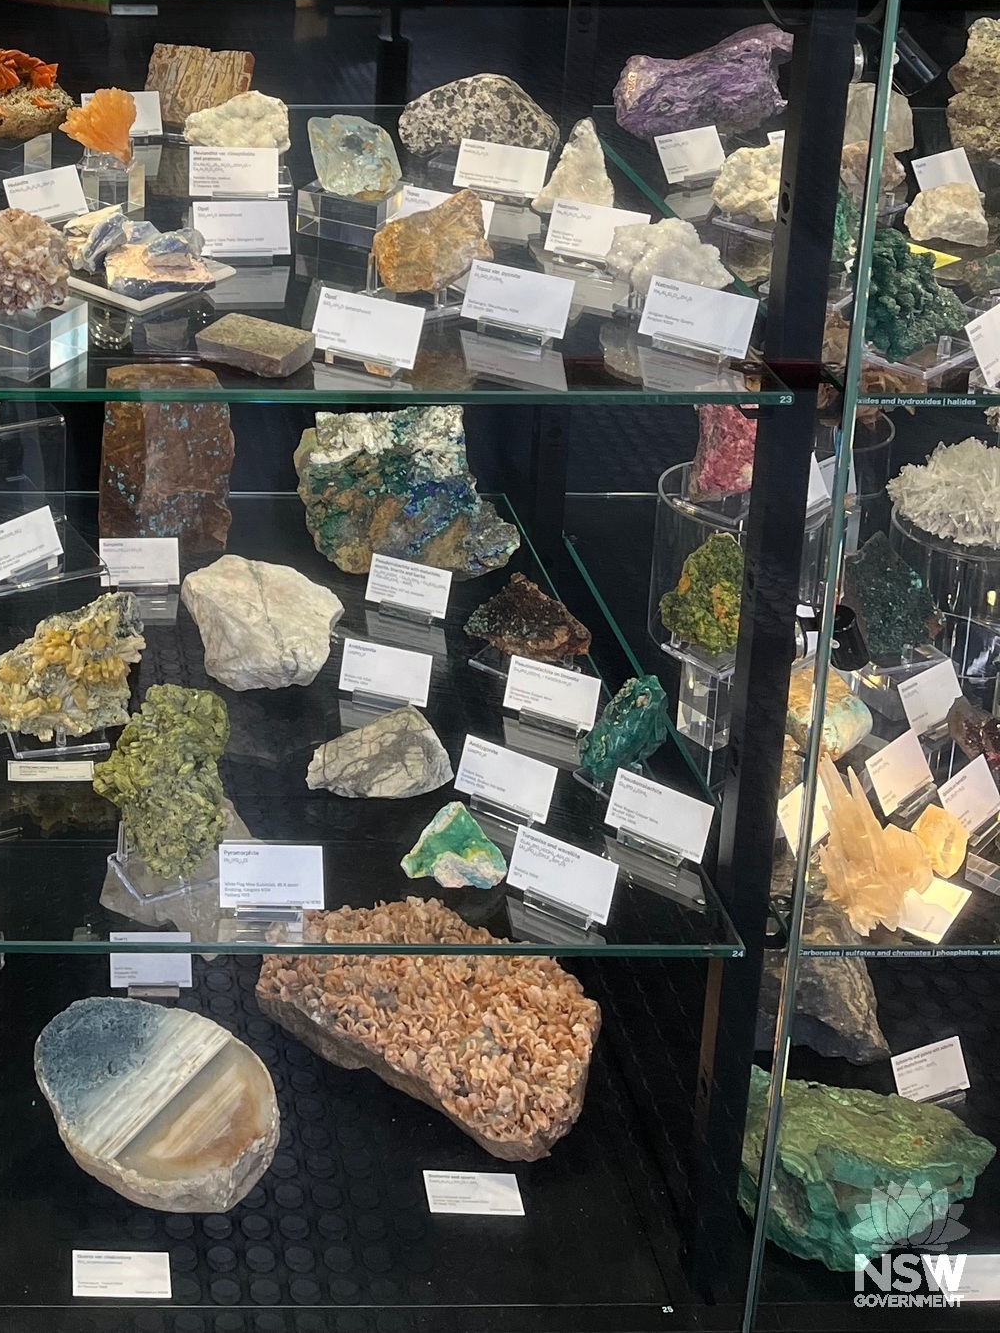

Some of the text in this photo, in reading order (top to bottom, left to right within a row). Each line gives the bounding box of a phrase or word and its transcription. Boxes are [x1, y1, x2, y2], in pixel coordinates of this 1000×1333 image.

[655, 281, 680, 292] Natrolite
[324, 292, 338, 300] Opal
[779, 395, 793, 404] 23
[857, 397, 976, 407] xides and hydroxides halides
[224, 850, 260, 858] Pyromorphite
[731, 950, 745, 958] 24
[845, 949, 875, 957] sulfates
[876, 949, 891, 957] and
[892, 949, 931, 957] chromates
[936, 949, 981, 958] phosphates,
